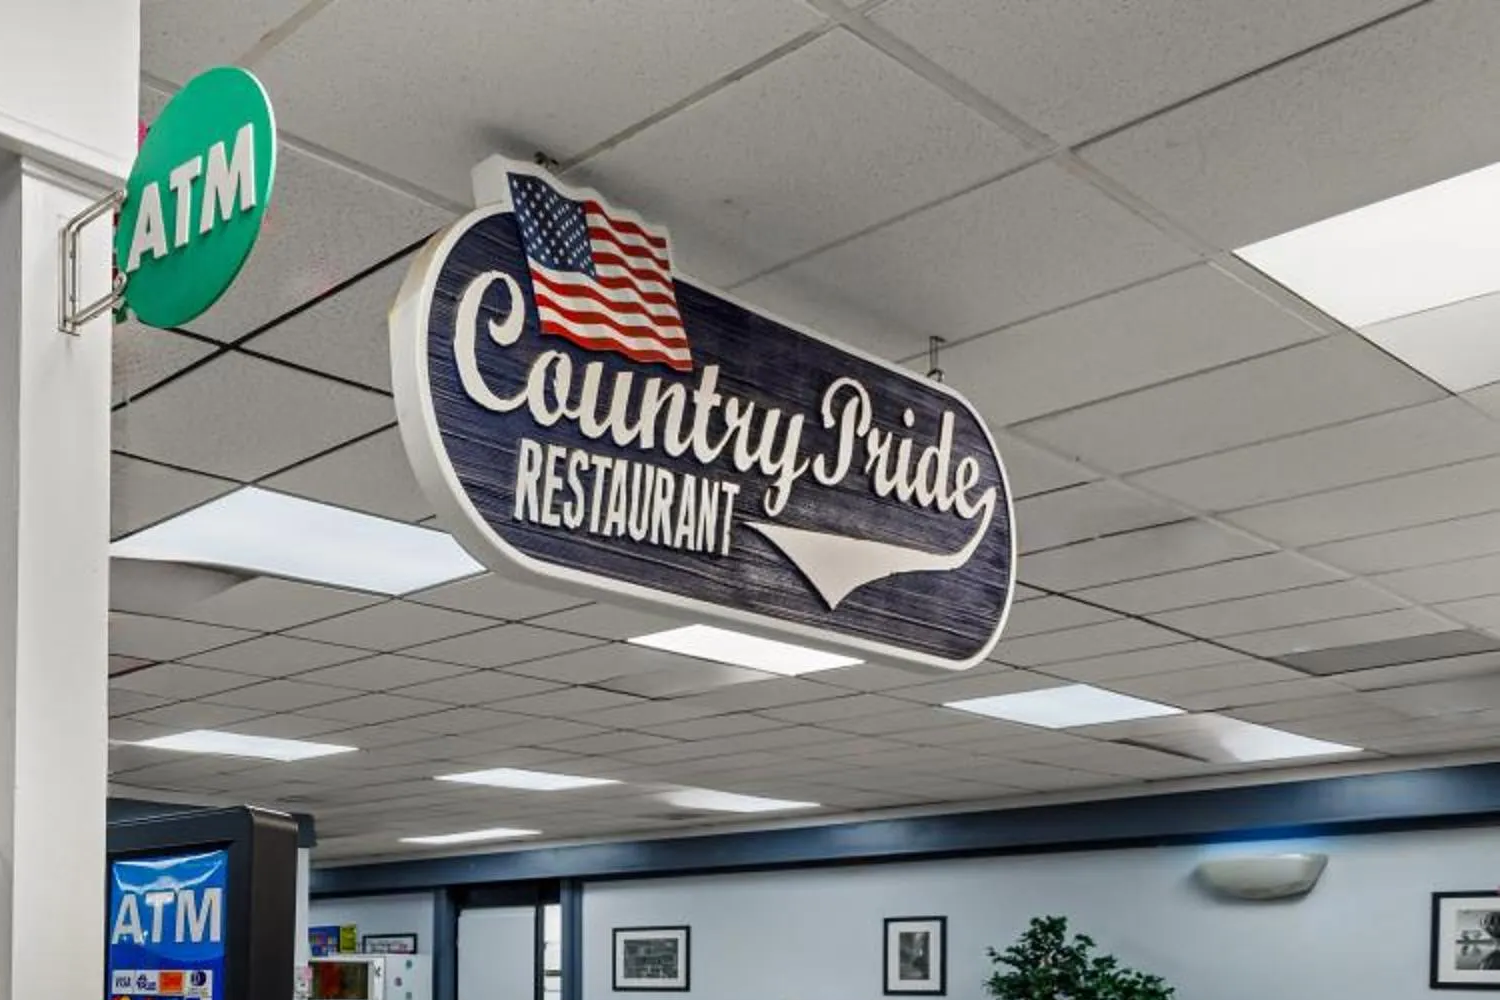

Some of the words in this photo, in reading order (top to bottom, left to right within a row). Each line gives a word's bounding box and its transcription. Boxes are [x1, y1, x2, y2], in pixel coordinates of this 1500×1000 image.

[126, 122, 257, 274] ATM
[453, 270, 810, 517] Country
[812, 376, 997, 520] Pride
[513, 438, 741, 557] RESTAURANT
[111, 887, 222, 945] ATM
